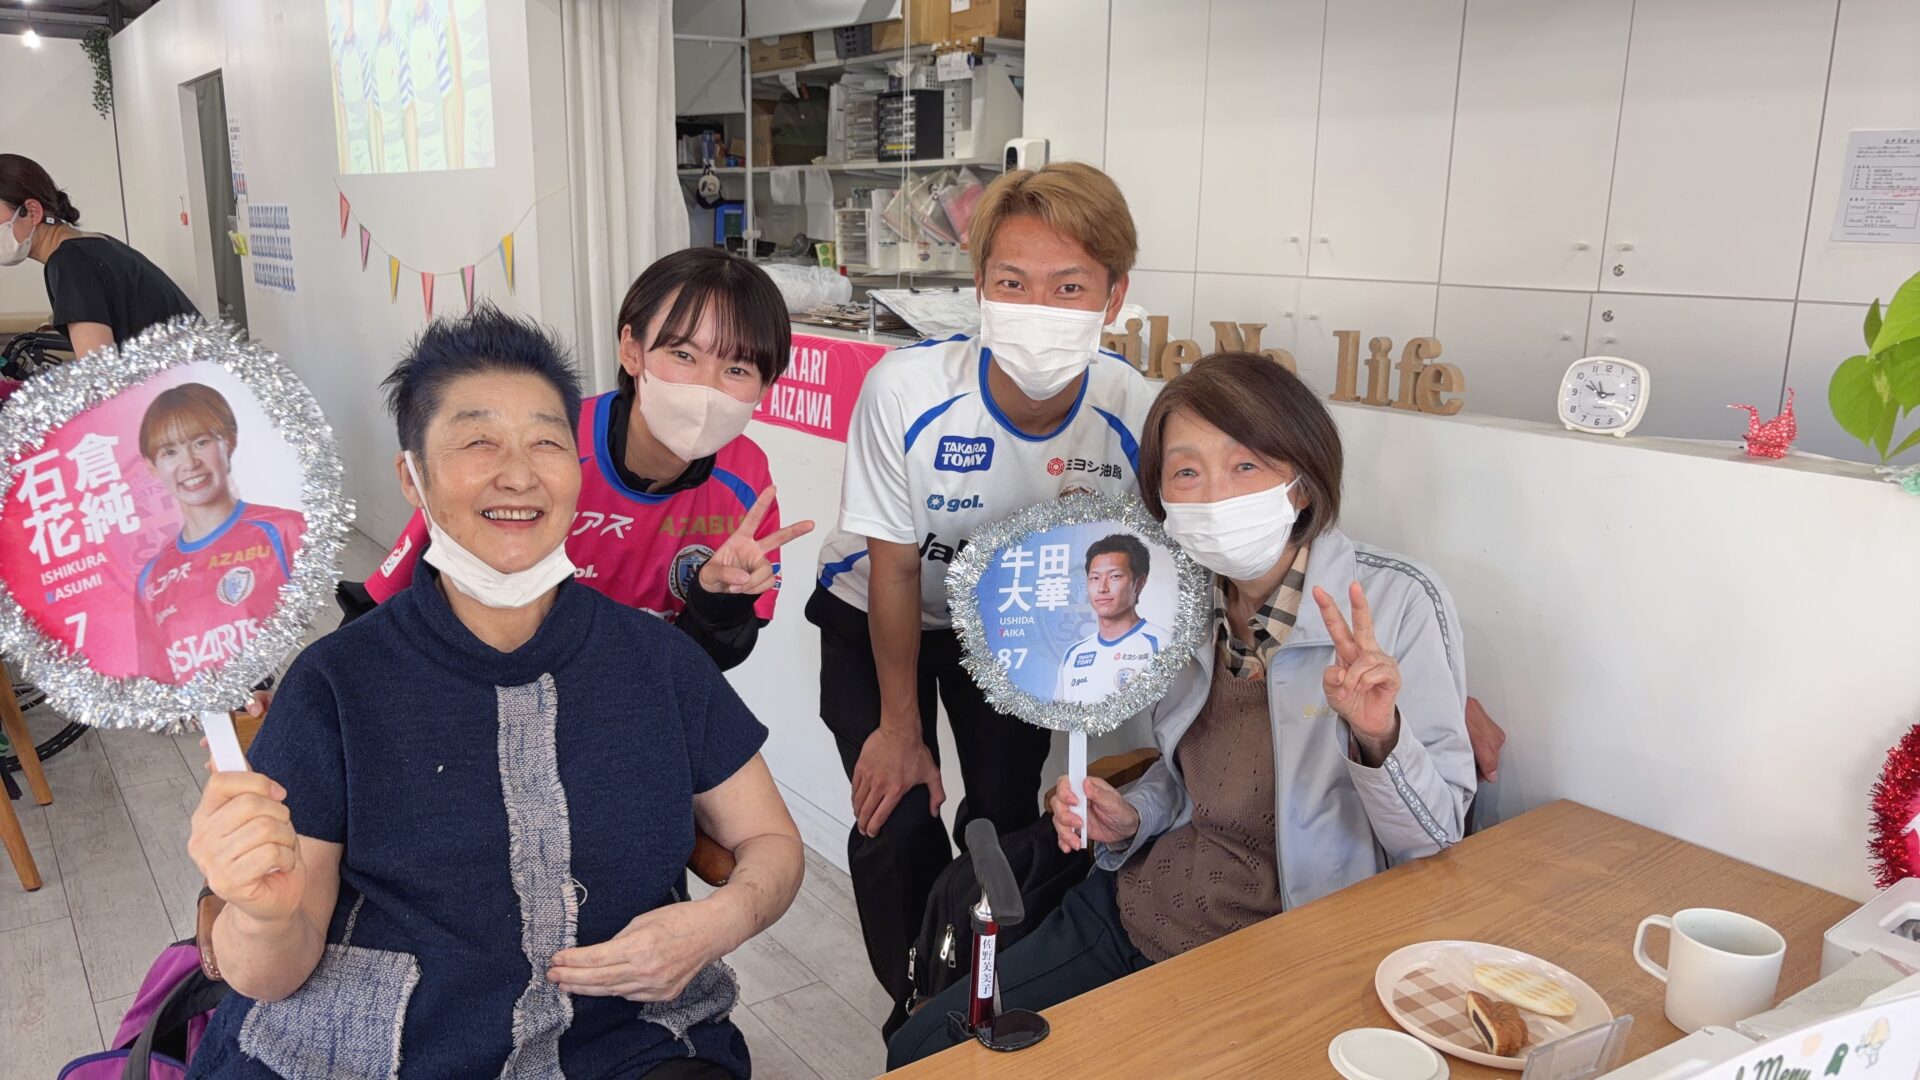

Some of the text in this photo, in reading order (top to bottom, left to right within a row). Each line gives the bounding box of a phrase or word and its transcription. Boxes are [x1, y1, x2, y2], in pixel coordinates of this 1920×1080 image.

[782, 345, 828, 386] KARI
[1329, 330, 1466, 415] life
[769, 384, 833, 430] AIZAWA
[941, 452, 987, 468] TOMY
[943, 441, 987, 454] TAKARA
[13, 433, 123, 510] 石倉
[946, 494, 984, 513] gol.
[23, 482, 141, 566] 花純
[571, 511, 635, 539] アズ
[40, 551, 108, 587] ISHIKURA
[208, 544, 272, 570] AZABU
[574, 564, 599, 578] ol.
[1000, 543, 1070, 578] 牛田
[45, 575, 104, 605] KASUMI
[997, 577, 1071, 613] 大華
[65, 611, 88, 649] 7
[999, 616, 1035, 626] USHIDA
[999, 628, 1025, 638] TAIKA
[997, 647, 1028, 670] 87
